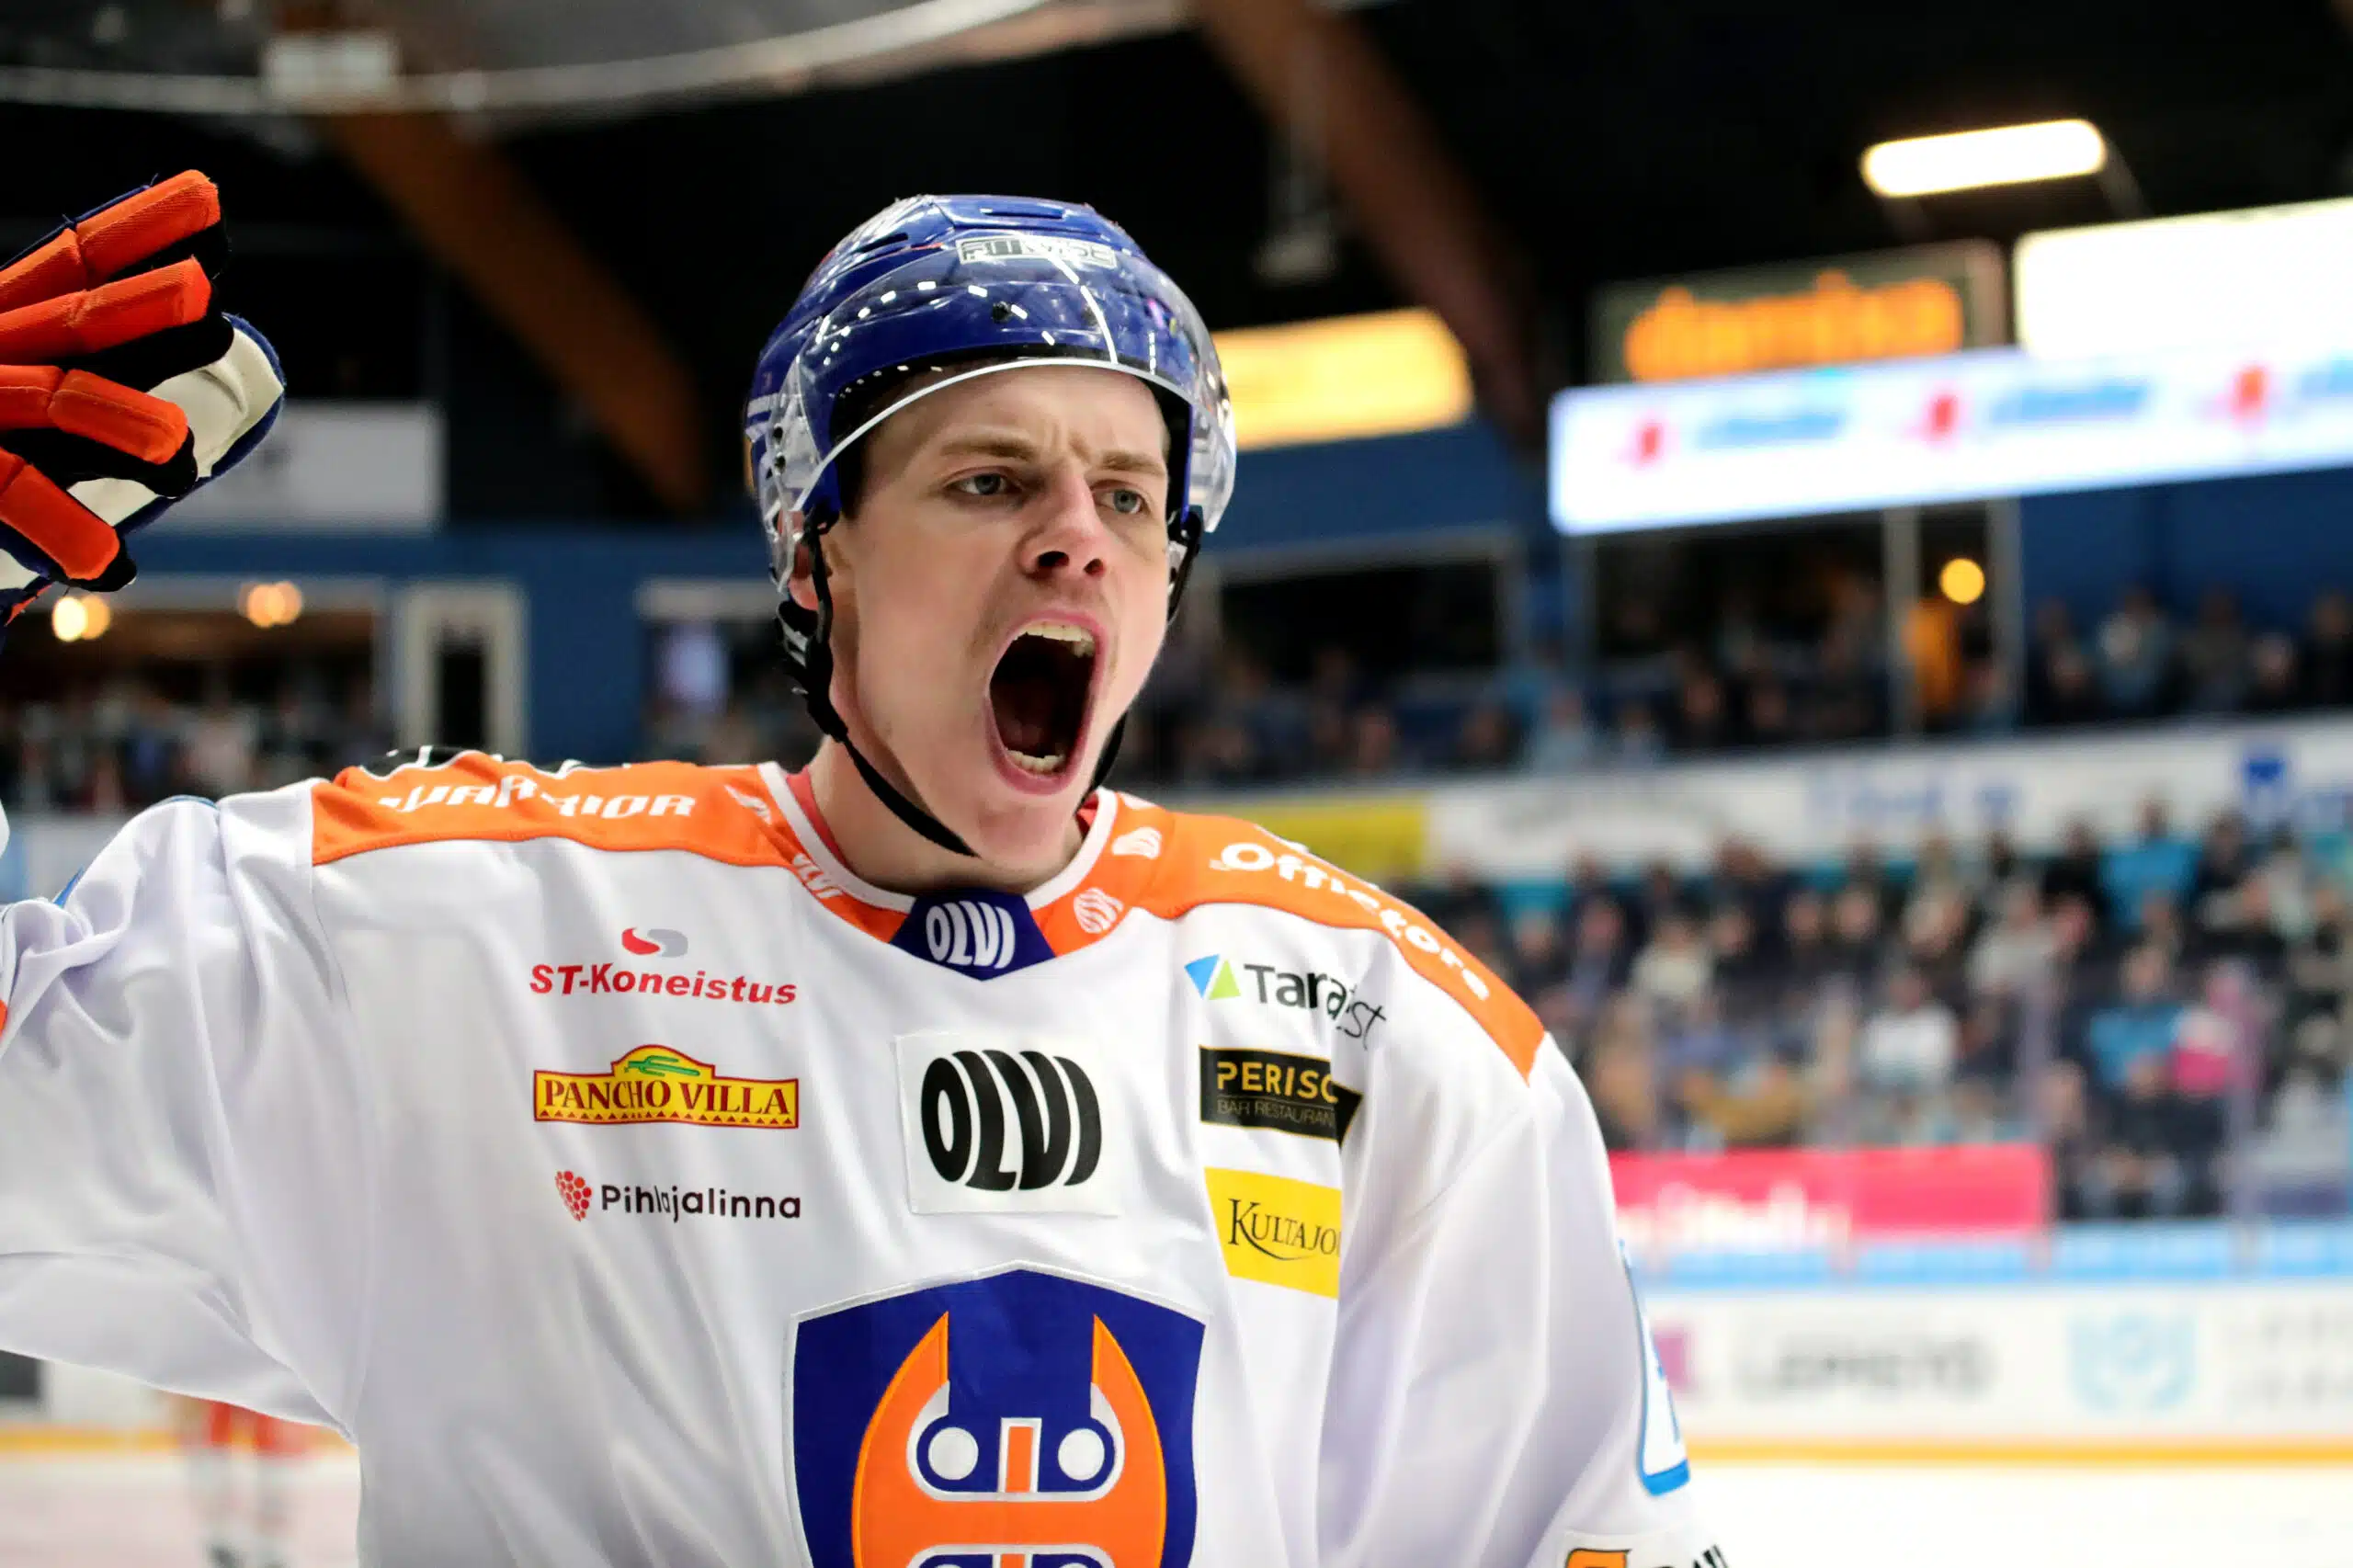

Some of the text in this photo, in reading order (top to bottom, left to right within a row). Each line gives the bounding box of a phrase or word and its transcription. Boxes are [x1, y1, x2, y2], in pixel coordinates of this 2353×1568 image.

[926, 901, 1016, 969] OLVI
[529, 962, 797, 1005] ST-Koneistus
[544, 1080, 790, 1115] PANCHO VILLA
[1217, 1062, 1338, 1103] PERISC
[921, 1050, 1102, 1191] OLVI
[1256, 1102, 1334, 1125] RESTAURAN
[601, 1185, 801, 1222] Pihlajalinna
